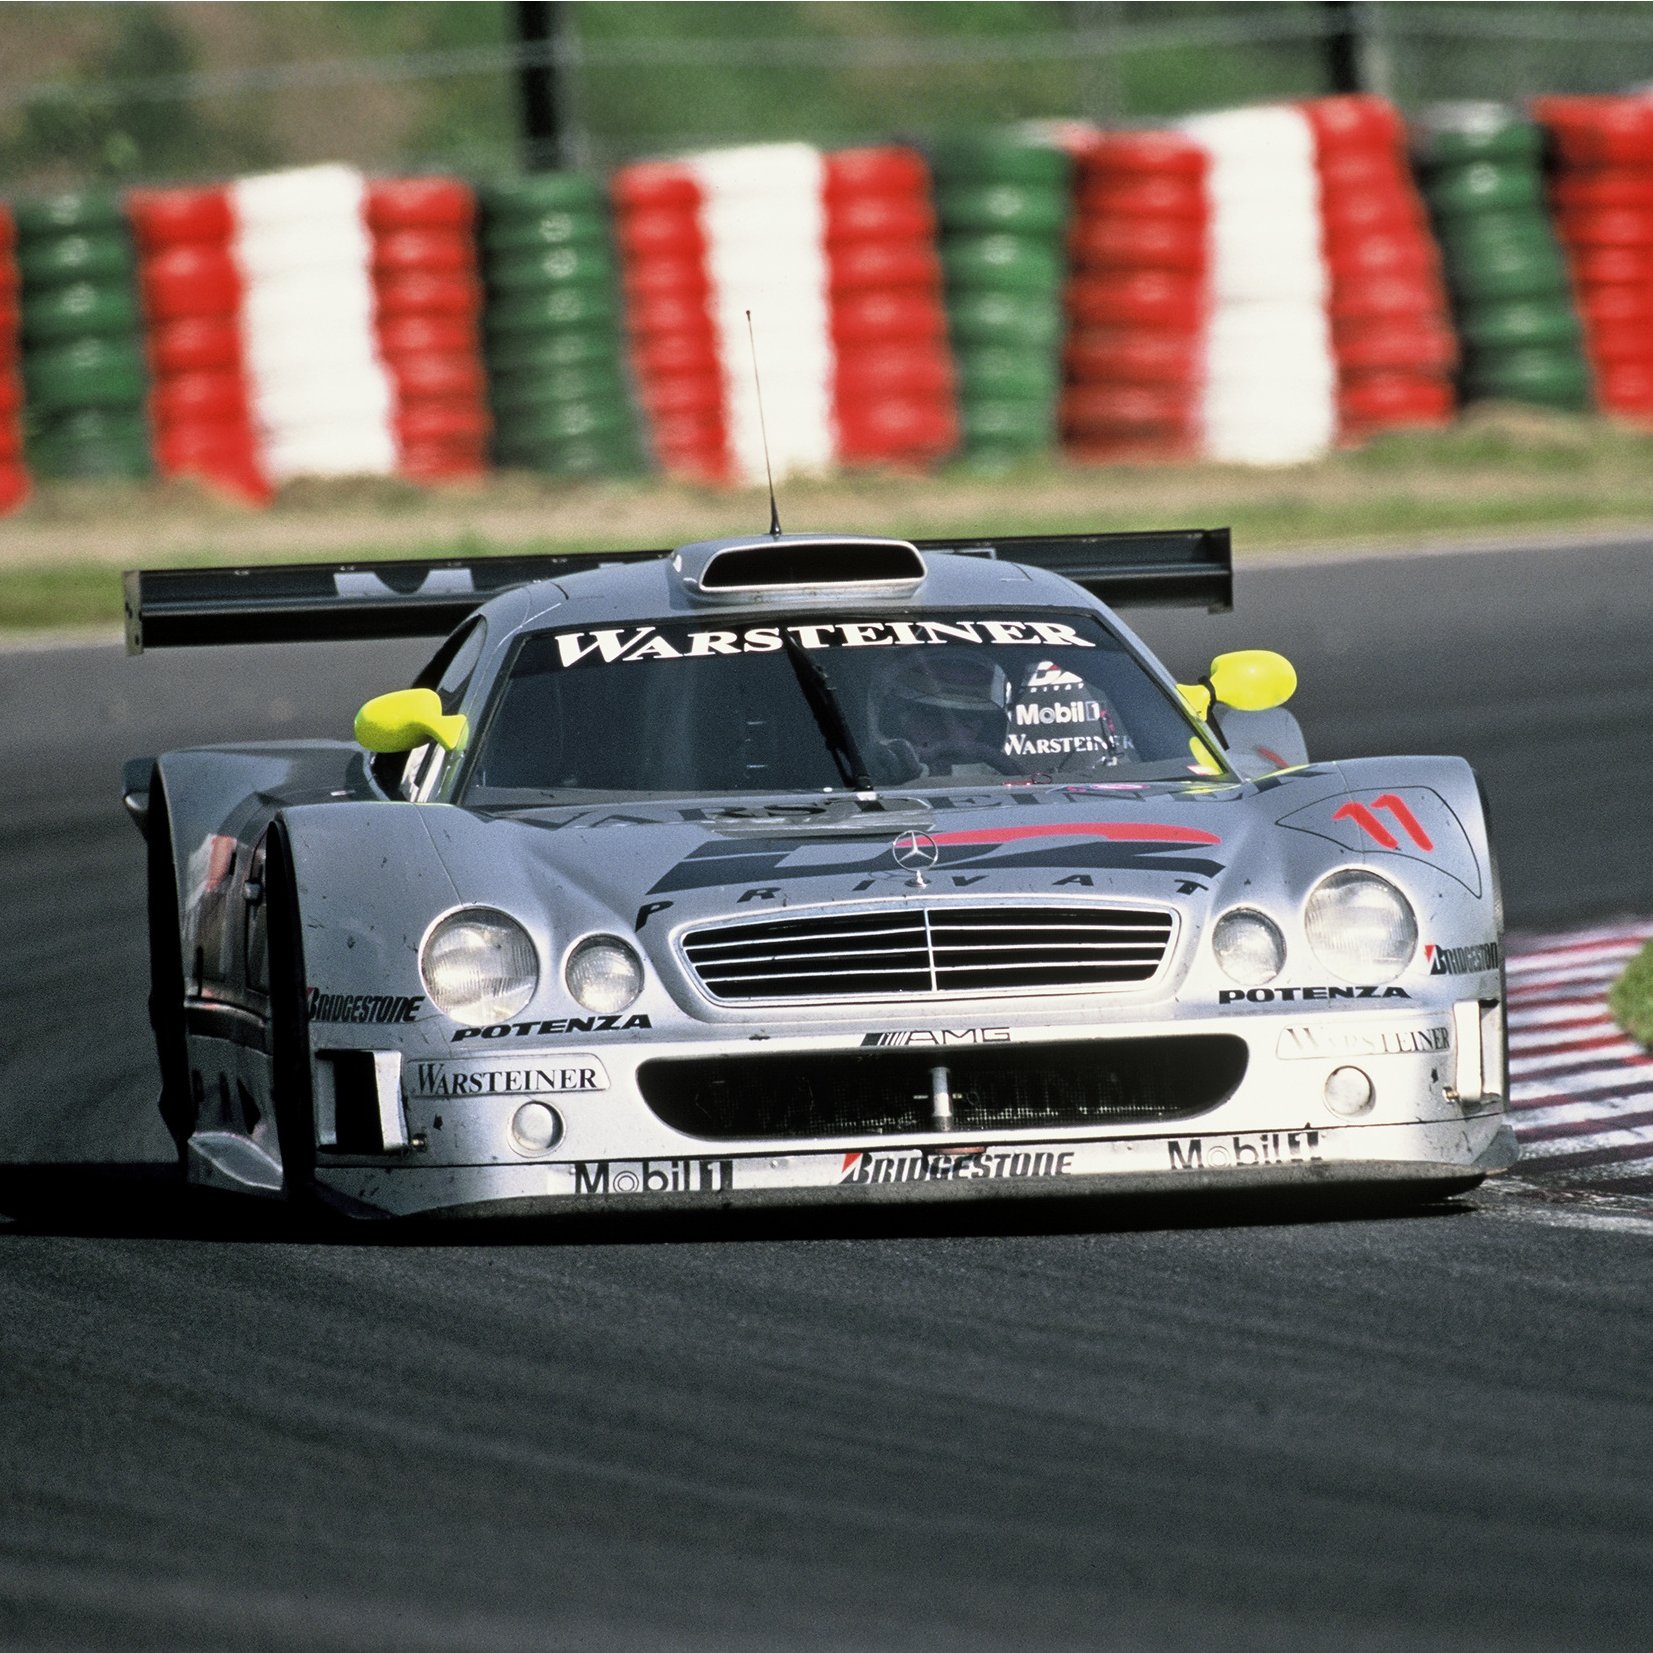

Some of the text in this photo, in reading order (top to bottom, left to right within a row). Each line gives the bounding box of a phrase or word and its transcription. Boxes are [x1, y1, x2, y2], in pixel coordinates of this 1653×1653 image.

[556, 620, 1096, 667] WARSTEINER
[1016, 701, 1084, 725] Mobil
[1332, 794, 1434, 853] 11
[635, 873, 1209, 932] PRIVAT
[1424, 942, 1498, 975] BRIDGESTON
[306, 986, 425, 1022] BRIDGESTONE
[1219, 986, 1412, 1004] POTENZA
[451, 1014, 652, 1042] POTENZA
[904, 1027, 1011, 1045] AMG
[1286, 1027, 1450, 1052] WSTEINER
[418, 1063, 597, 1094] WARSTEINER
[1168, 1133, 1280, 1170] Mobil
[575, 1161, 728, 1193] Mobil 1
[838, 1152, 1074, 1184] BRIDGESTONE
